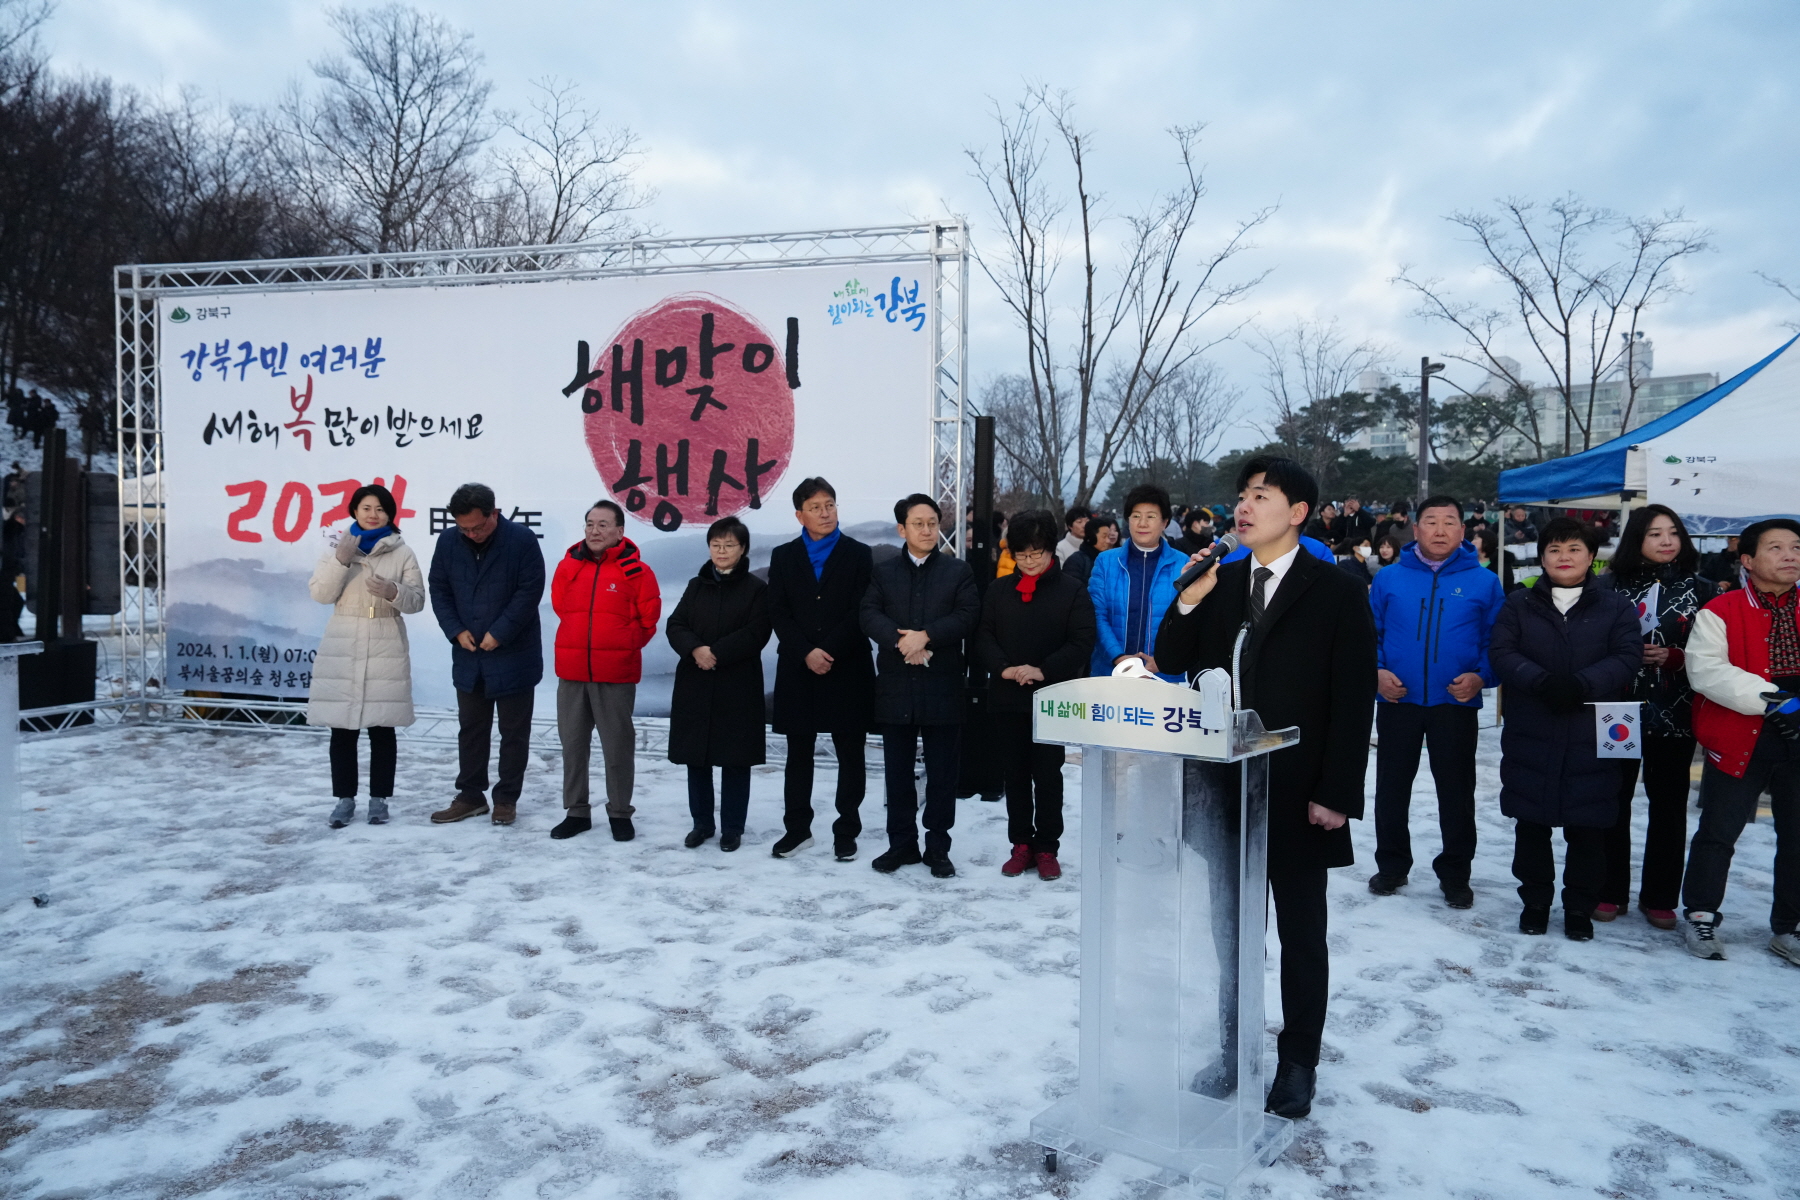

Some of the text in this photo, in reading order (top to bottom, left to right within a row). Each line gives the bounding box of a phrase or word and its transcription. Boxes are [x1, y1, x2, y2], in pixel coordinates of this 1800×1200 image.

[196, 306, 231, 321] 강북구
[873, 276, 927, 332] 강북
[180, 337, 386, 382] 강북구민 여러분
[562, 312, 802, 426] 해맞이
[283, 373, 317, 452] 복
[324, 406, 380, 447] 많이
[386, 405, 484, 448] 받으세요
[1684, 455, 1717, 464] 강북구
[612, 438, 778, 532] 행사
[176, 642, 217, 659] 2024.
[222, 644, 234, 660] 1.
[283, 648, 317, 664] 07:0
[177, 663, 265, 686] 북서울꿈의숲
[1041, 699, 1055, 718] 내
[1057, 701, 1087, 720] 삶에
